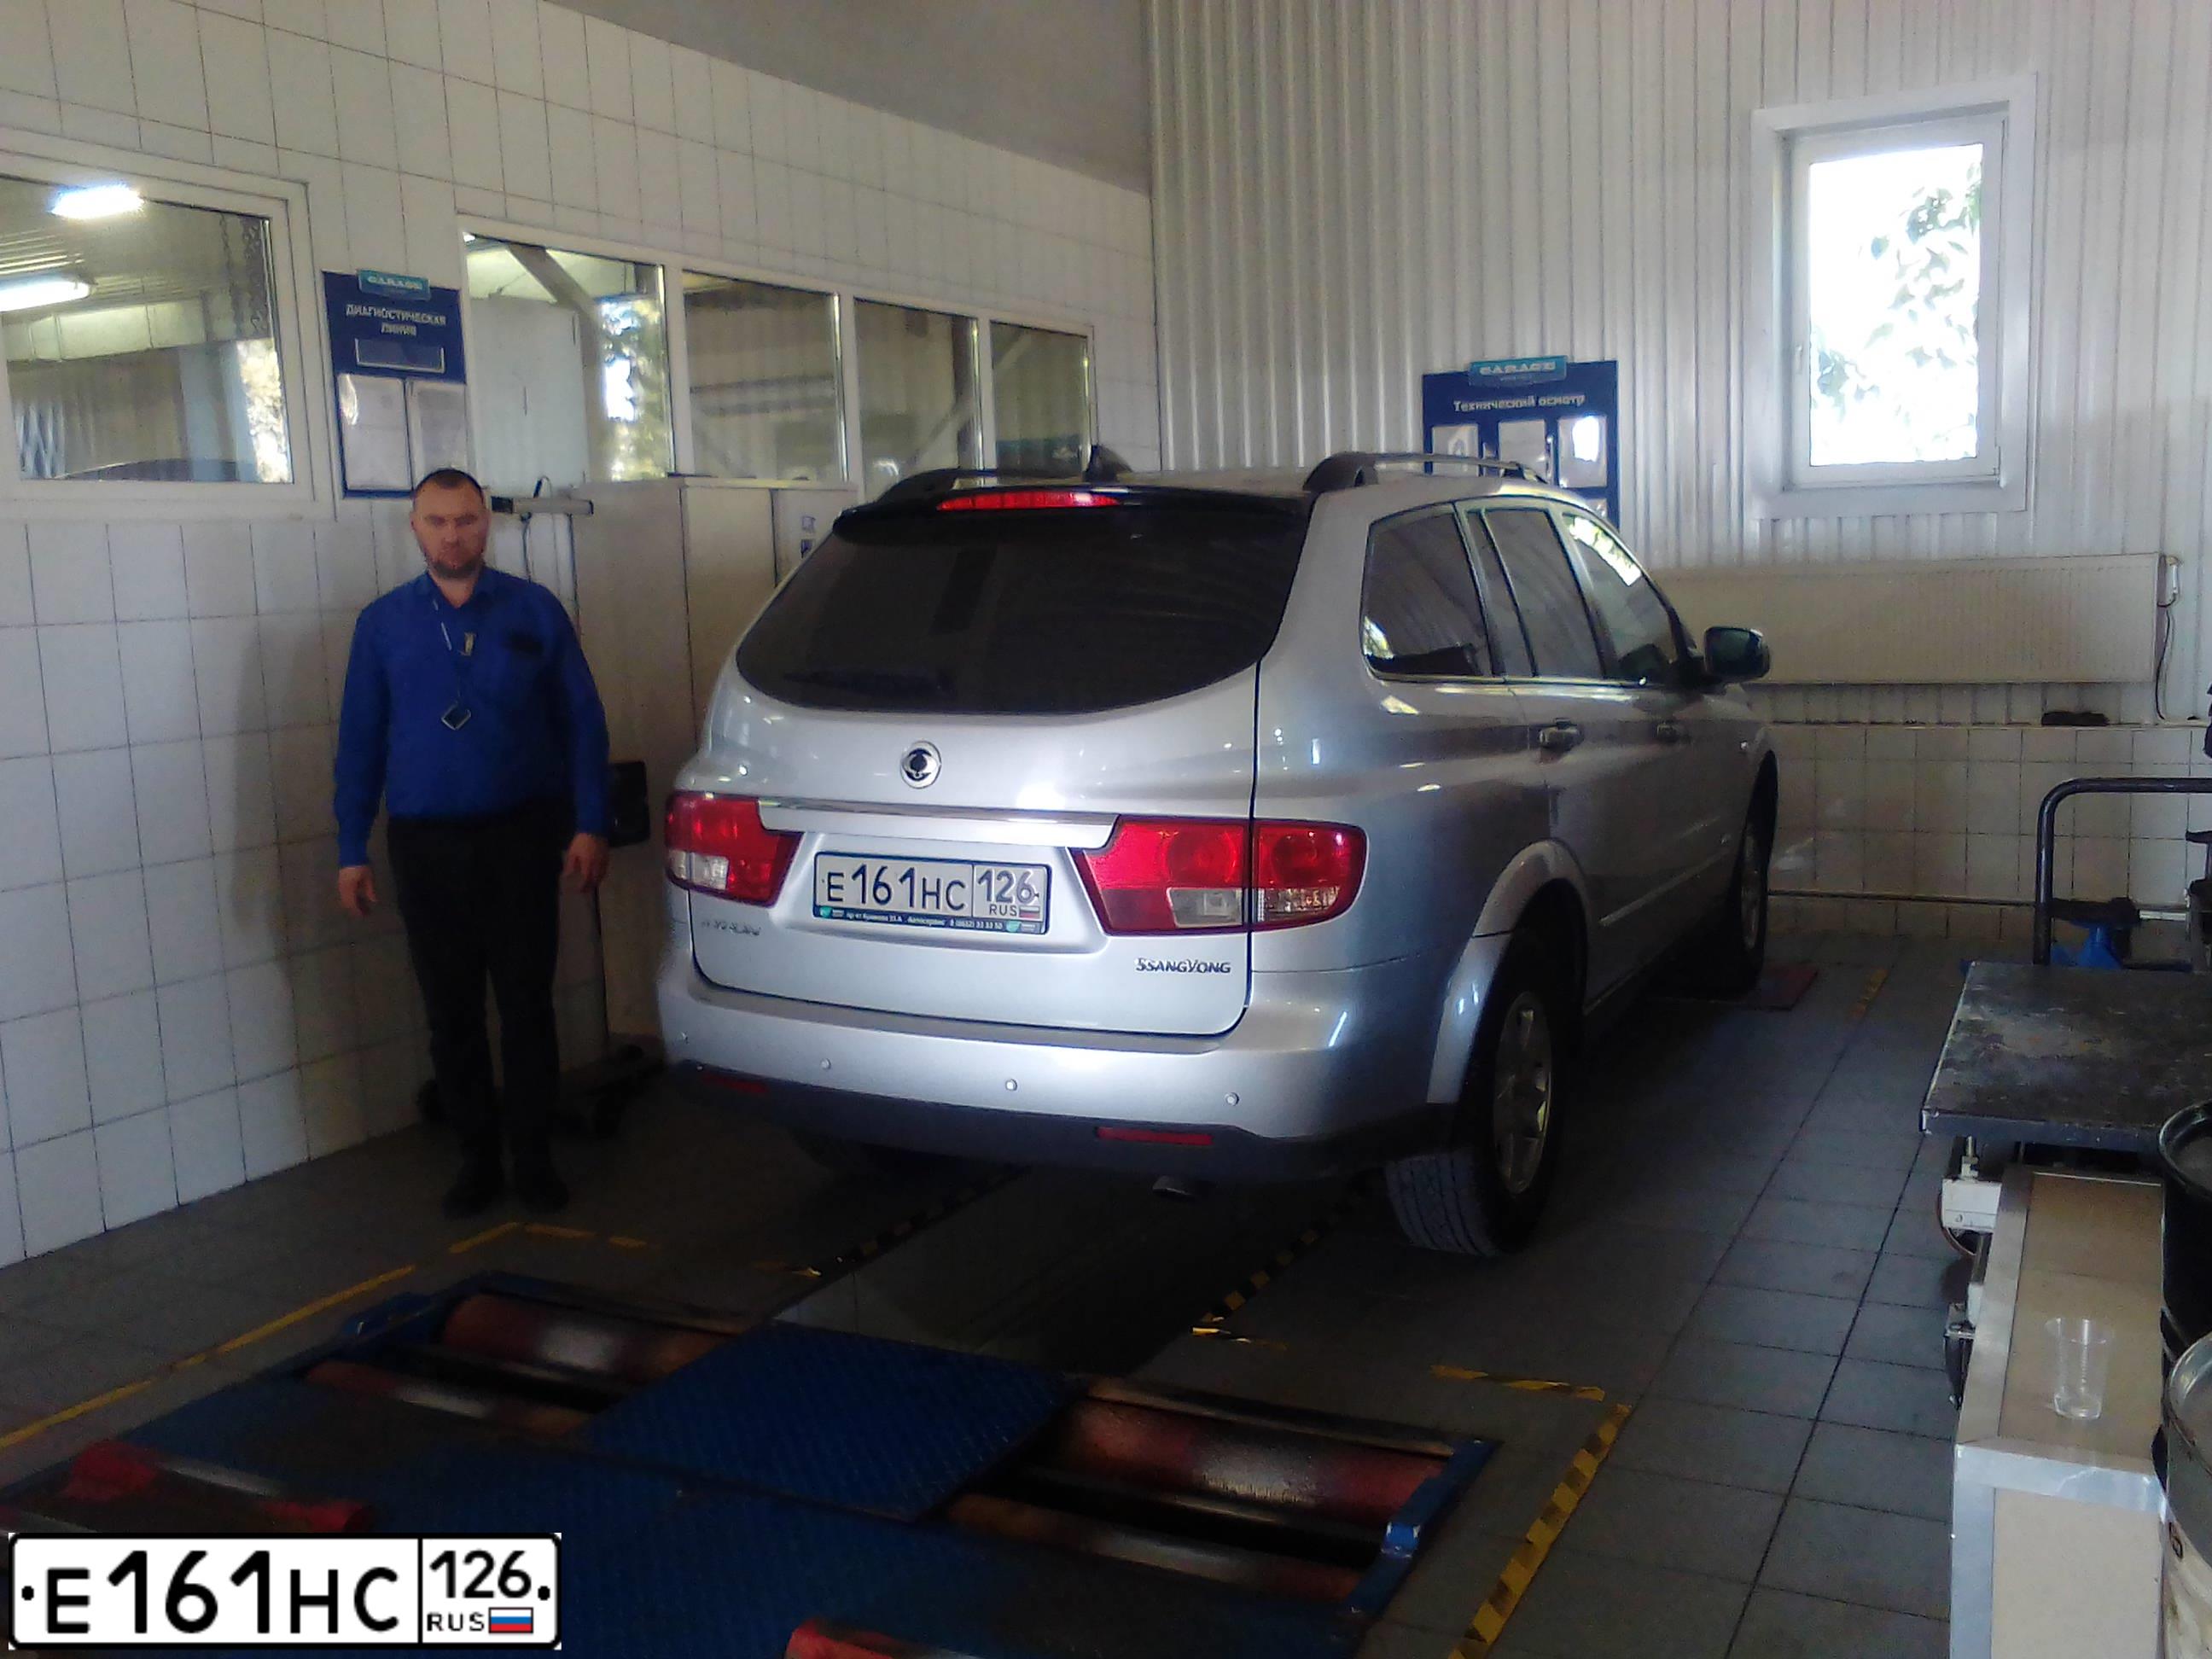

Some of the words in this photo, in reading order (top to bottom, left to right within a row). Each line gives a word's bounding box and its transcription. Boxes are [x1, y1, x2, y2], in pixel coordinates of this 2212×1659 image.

[346, 303, 446, 326] ДИАГНОСТИЧЕСКАЯ
[1453, 395, 1535, 412] Технический
[1538, 394, 1585, 407] осмотр
[977, 868, 1036, 905] 126
[988, 903, 1018, 917] RUS
